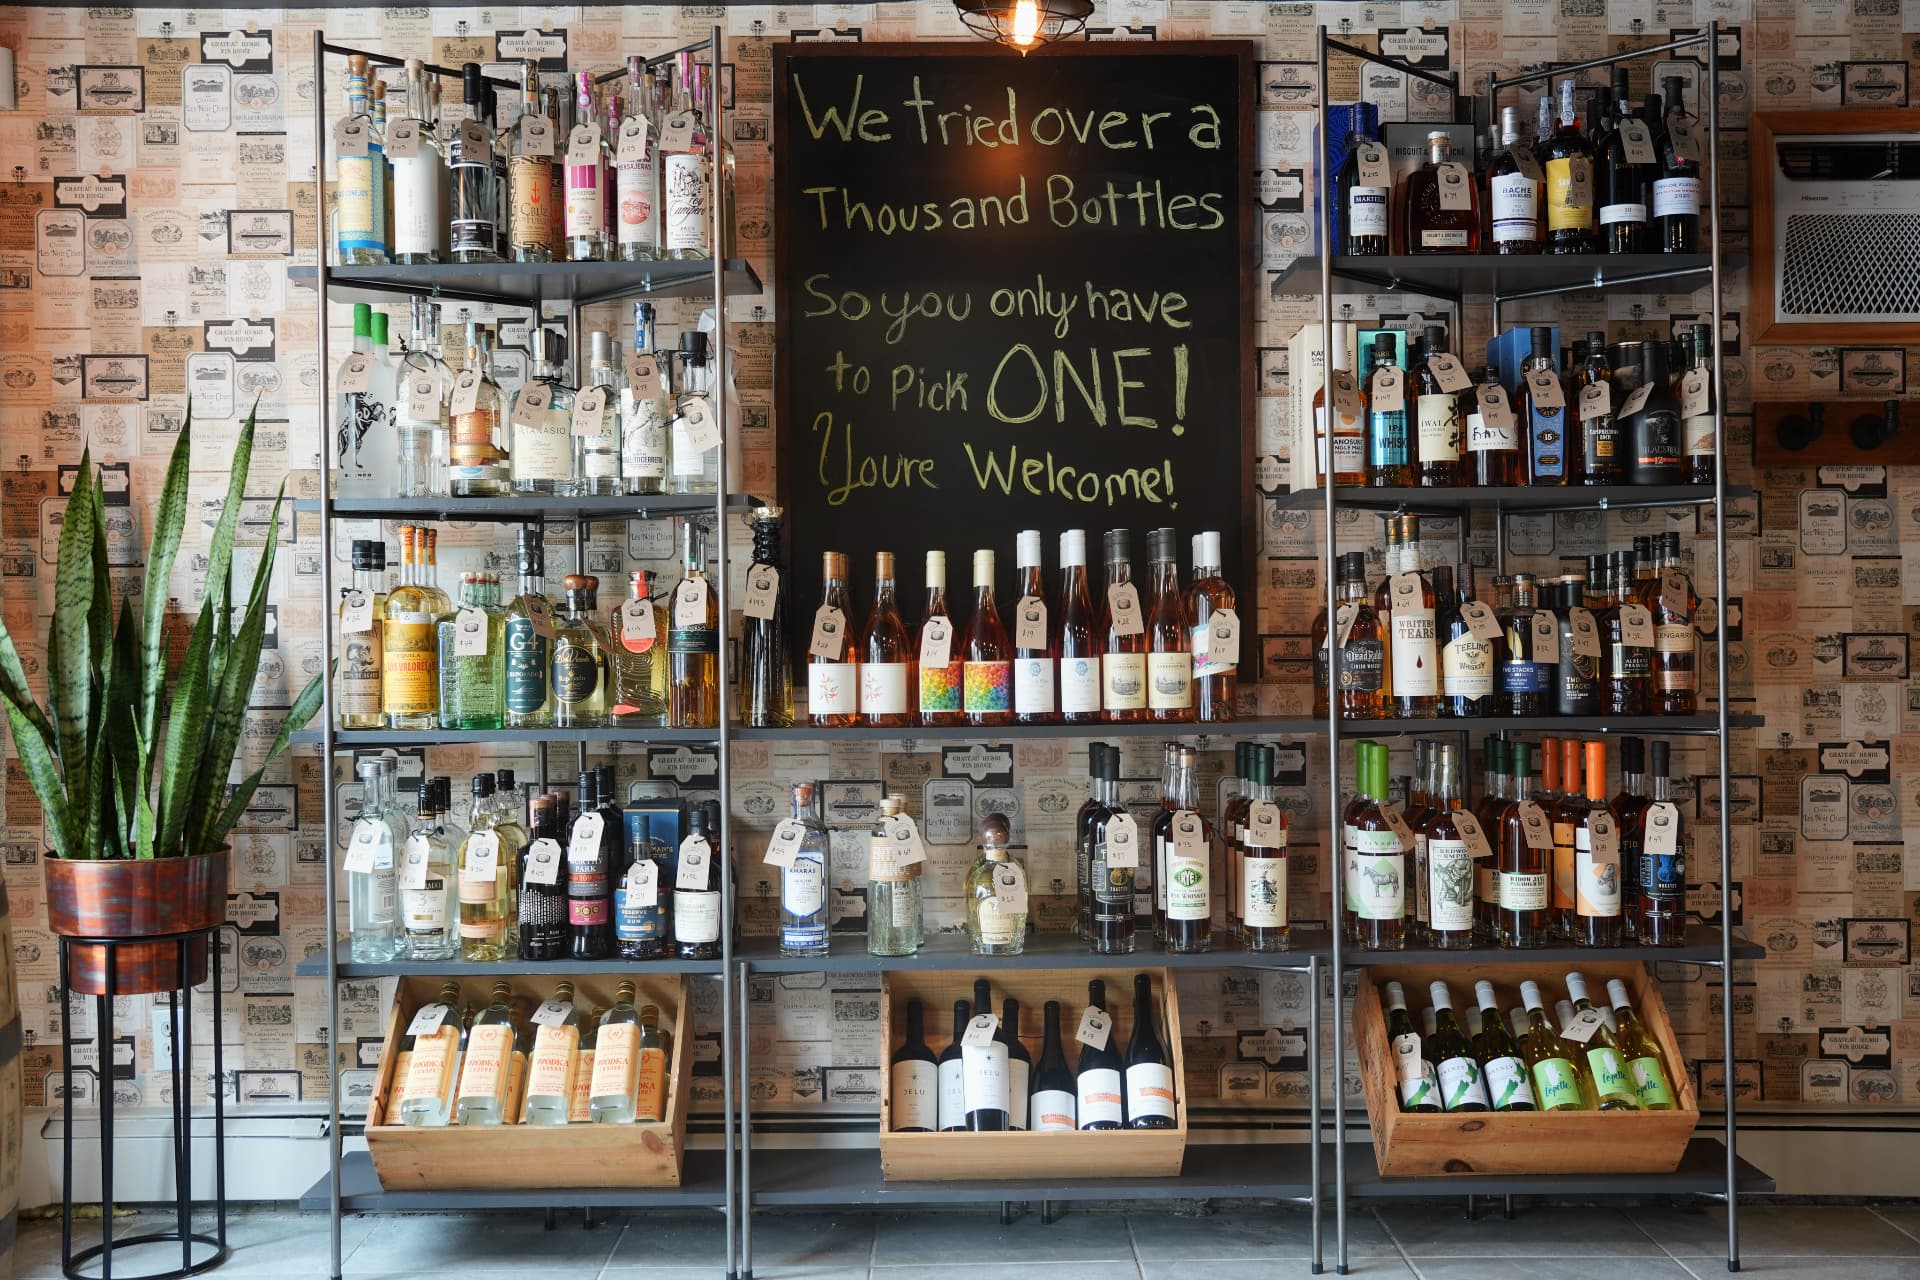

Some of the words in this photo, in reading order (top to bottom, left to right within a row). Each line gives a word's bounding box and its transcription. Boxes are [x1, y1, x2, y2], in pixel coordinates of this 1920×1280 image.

[794, 73, 891, 142] We
[903, 75, 1019, 148] tried
[1031, 107, 1171, 149] over
[1188, 104, 1222, 150] a
[803, 174, 1029, 235] Thousand
[1046, 174, 1225, 230] Bottles
[804, 274, 871, 321] So
[881, 291, 971, 344] you
[990, 274, 1077, 339] only
[1086, 281, 1192, 329] have
[826, 350, 871, 395] to
[986, 343, 1190, 436] ONE!
[812, 411, 940, 507] Youre
[963, 442, 1179, 510] Welcome!
[1399, 628, 1434, 639] TEARS
[1455, 642, 1489, 654] TEELING
[575, 865, 596, 873] PARK
